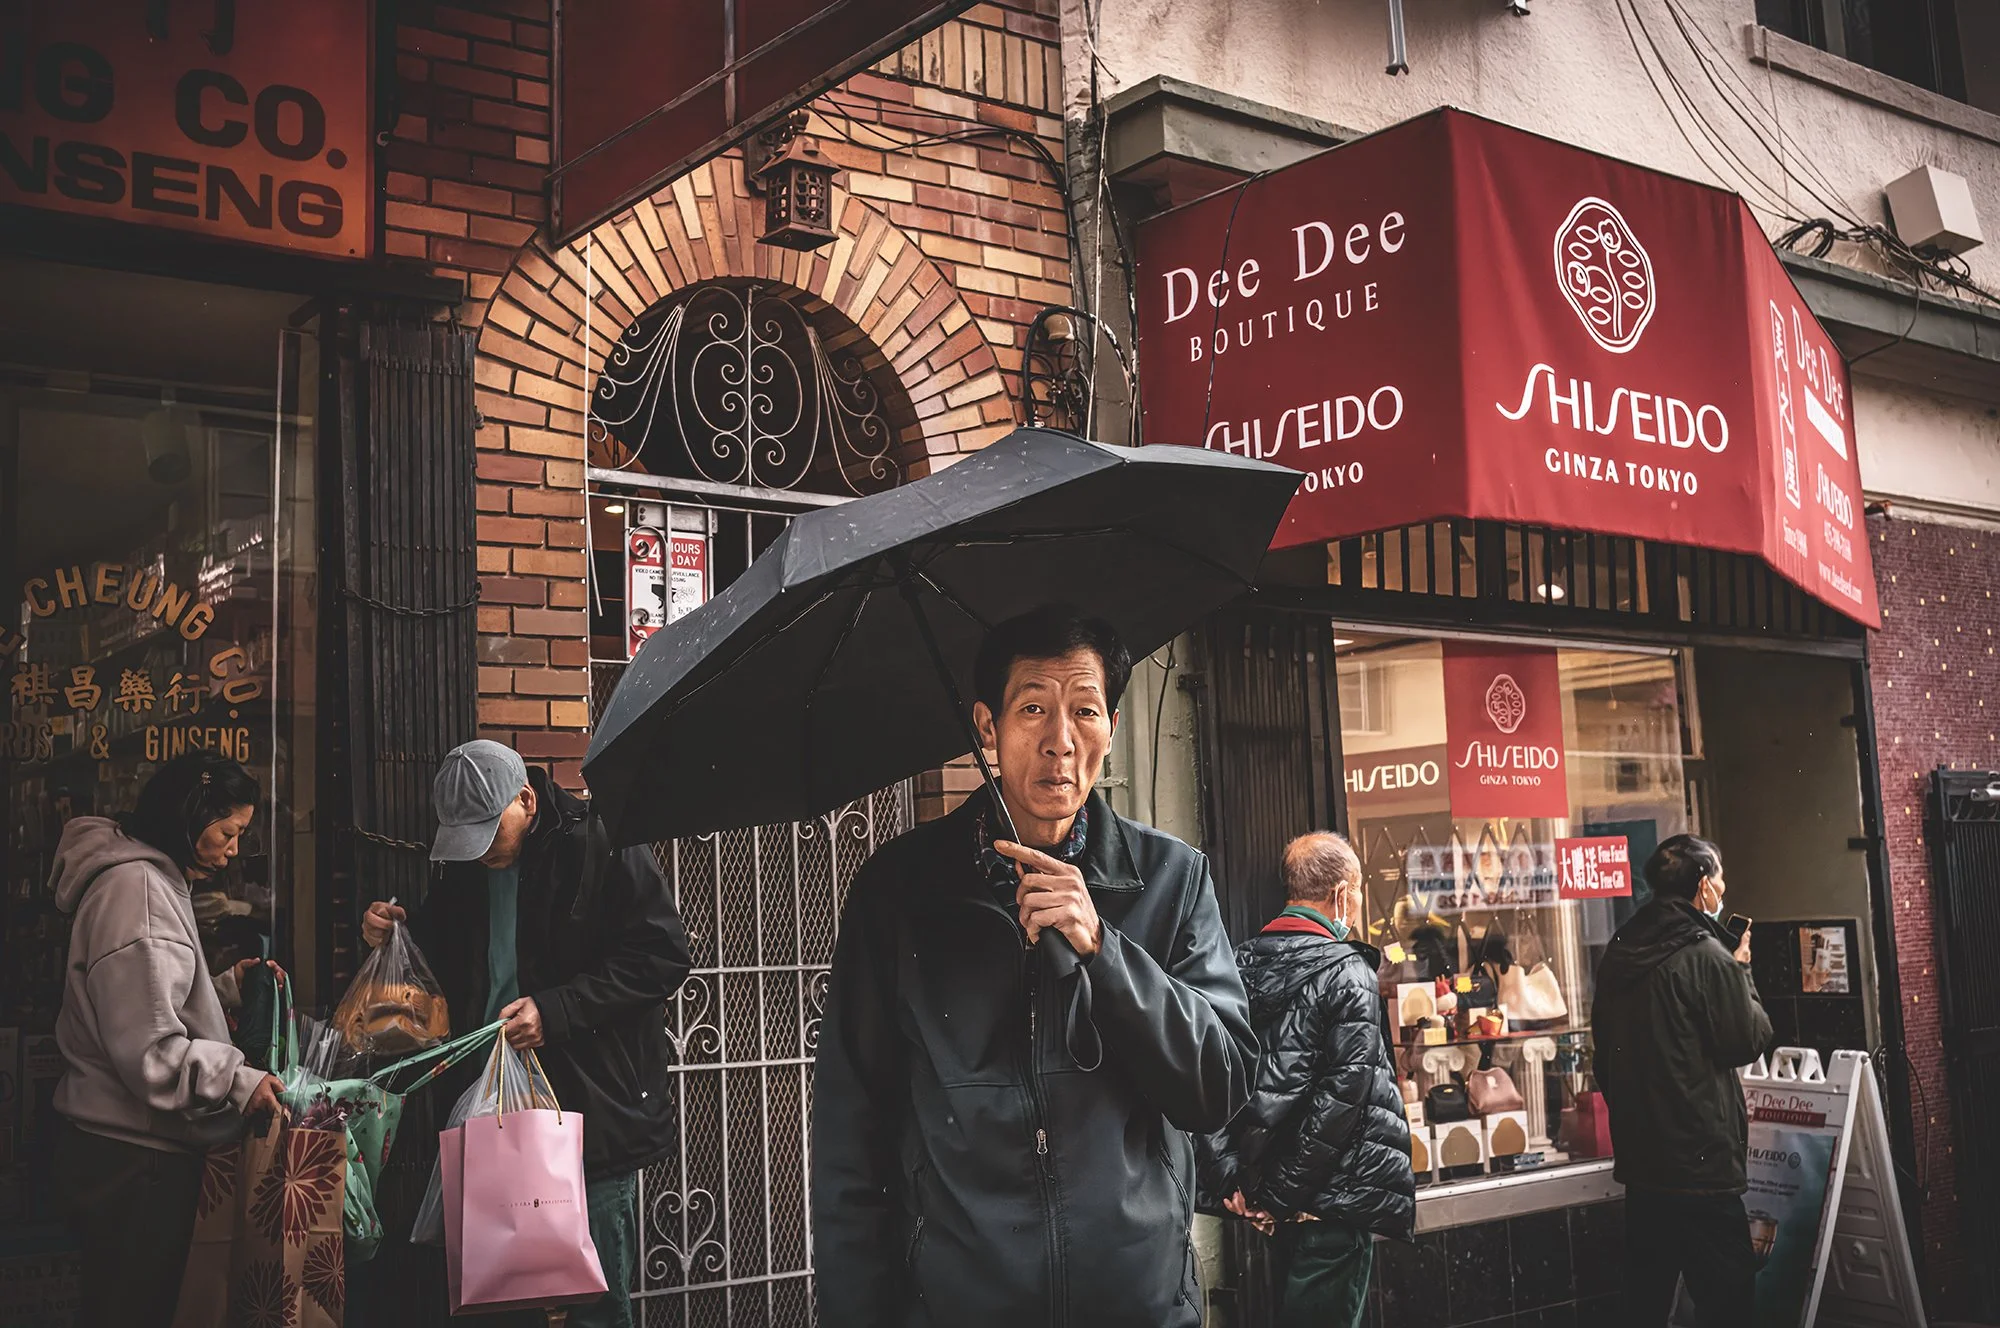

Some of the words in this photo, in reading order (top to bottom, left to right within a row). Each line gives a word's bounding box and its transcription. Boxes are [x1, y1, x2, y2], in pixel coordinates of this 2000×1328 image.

[175, 69, 348, 170] CO.
[0, 130, 344, 239] NSENG
[1162, 258, 1260, 324] Dee
[1291, 211, 1406, 282] Dee
[1190, 282, 1379, 362] BOUTIQUE
[1791, 305, 1819, 390] Dee
[1819, 345, 1845, 420] Dee
[1496, 363, 1729, 453] SHISEIDO
[1295, 461, 1364, 495] OKYO
[1545, 448, 1619, 484] GINZA
[1625, 462, 1697, 495] TOKYO
[1815, 463, 1853, 530] SHISEIDO
[671, 542, 701, 554] OURS
[677, 555, 698, 566] DAY
[23, 564, 215, 641] CHEUNG
[209, 646, 262, 719] CO.
[90, 725, 110, 760] &
[145, 724, 250, 763] GINSENG
[1455, 741, 1559, 770] SHISEIDO
[1480, 775, 1507, 786] GINZA
[1512, 775, 1541, 786] TOKYO
[1598, 845, 1611, 863] Free
[1611, 844, 1628, 863] Facial
[1600, 871, 1613, 889] Free
[1612, 870, 1625, 888] Gift
[1759, 1110, 1812, 1123] BOUTIQUE
[1762, 1093, 1786, 1109] Dee
[1789, 1096, 1814, 1112] Dee
[1748, 1146, 1787, 1162] HISEIDO
